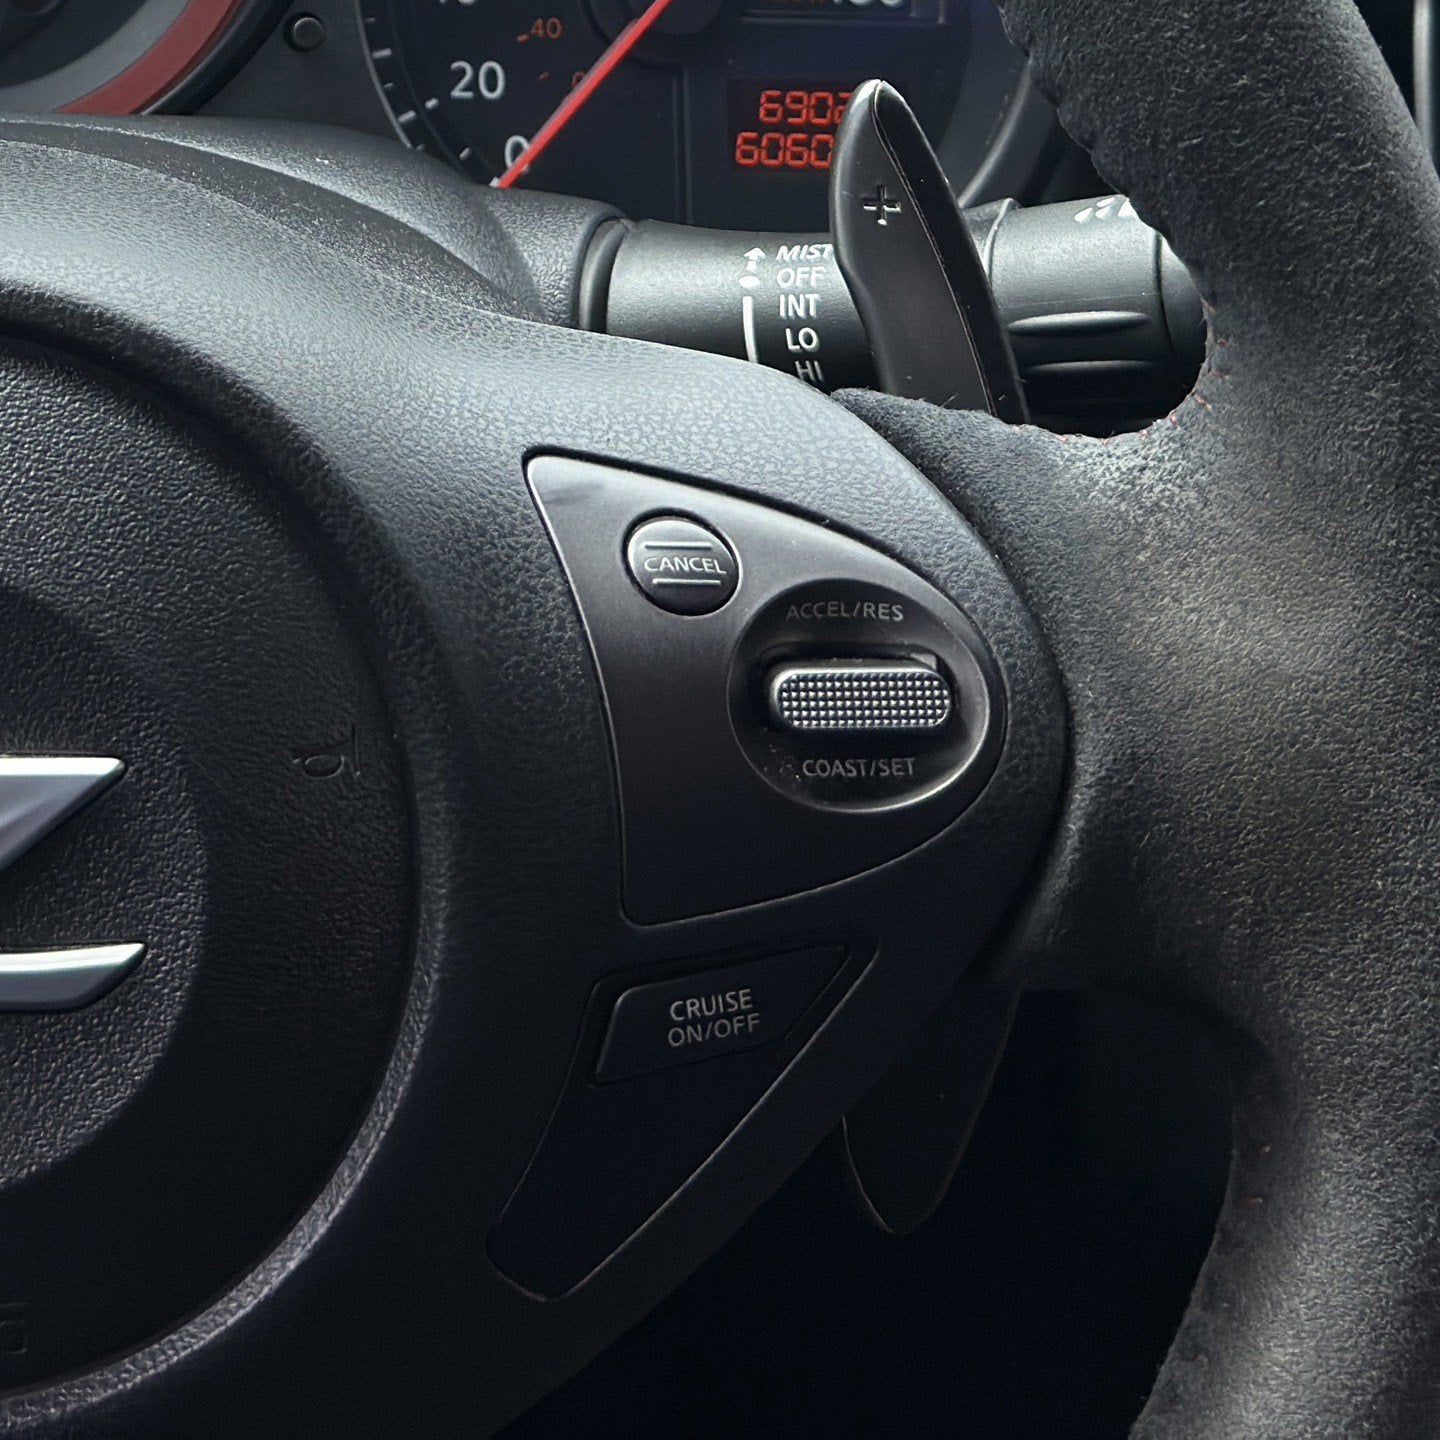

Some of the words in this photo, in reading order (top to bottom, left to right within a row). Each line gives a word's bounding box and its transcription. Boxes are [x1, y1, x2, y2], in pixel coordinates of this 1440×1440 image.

[531, 18, 562, 39] 40
[450, 60, 505, 100] 20
[776, 243, 834, 261] MIST
[776, 266, 825, 288] OFF
[780, 293, 819, 318] INT
[785, 327, 819, 351] LO
[794, 360, 824, 381] HI
[643, 555, 727, 576] CANCEL
[786, 601, 905, 622] ACCEL/RES
[803, 757, 915, 779] COAST/SET
[669, 988, 754, 1022] CRUISE
[667, 1013, 761, 1048] ON/OFF
